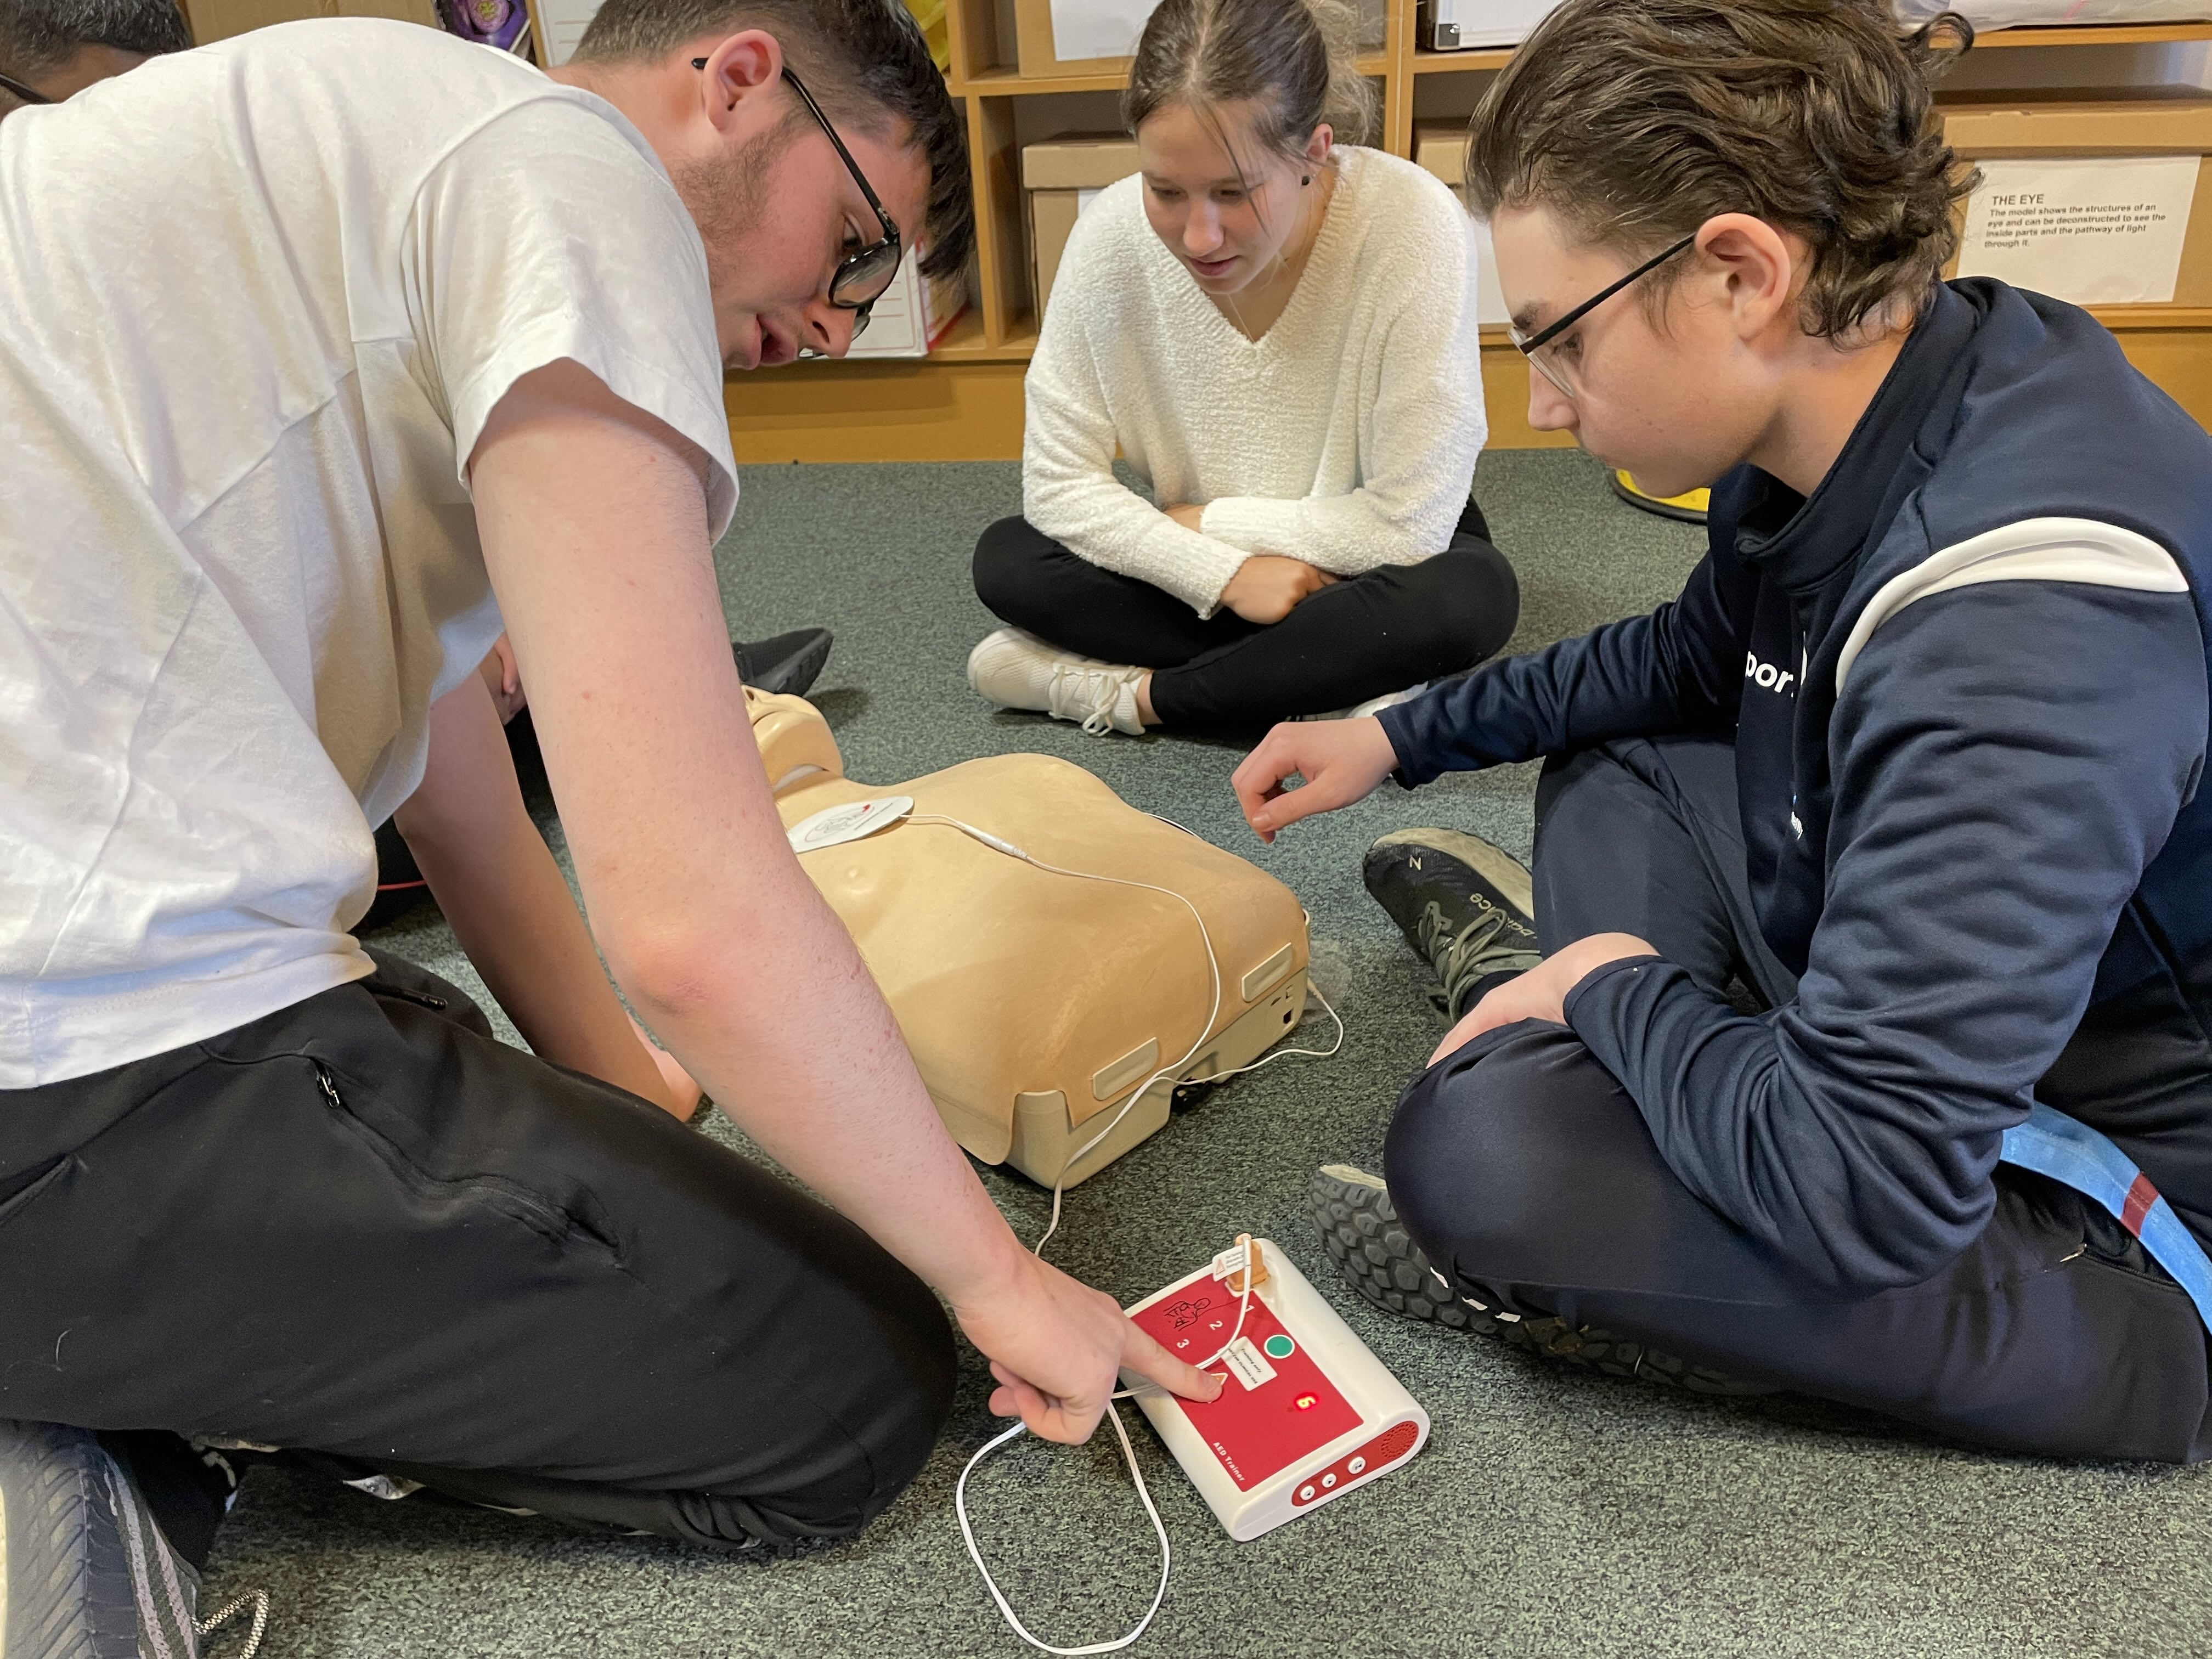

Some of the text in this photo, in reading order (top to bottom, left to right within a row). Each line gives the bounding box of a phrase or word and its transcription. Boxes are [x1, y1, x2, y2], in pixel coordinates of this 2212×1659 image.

[1993, 194, 2044, 206] THE EYE
[2008, 208, 2036, 216] model
[2039, 207, 2066, 215] shows
[2086, 205, 2131, 213] structures
[2057, 215, 2120, 224] deconstructed
[2015, 229, 2038, 237] parts
[2075, 225, 2112, 235] pathway
[2115, 224, 2125, 233] of
[2127, 224, 2146, 234] light
[1984, 239, 2019, 249] through
[1745, 651, 1793, 693] por
[1409, 854, 1421, 871] N
[1209, 1321, 1223, 1330] 2
[1176, 1339, 1190, 1348] 3
[1297, 1396, 1316, 1409] 6
[1213, 1442, 1245, 1481] AED Trainer
